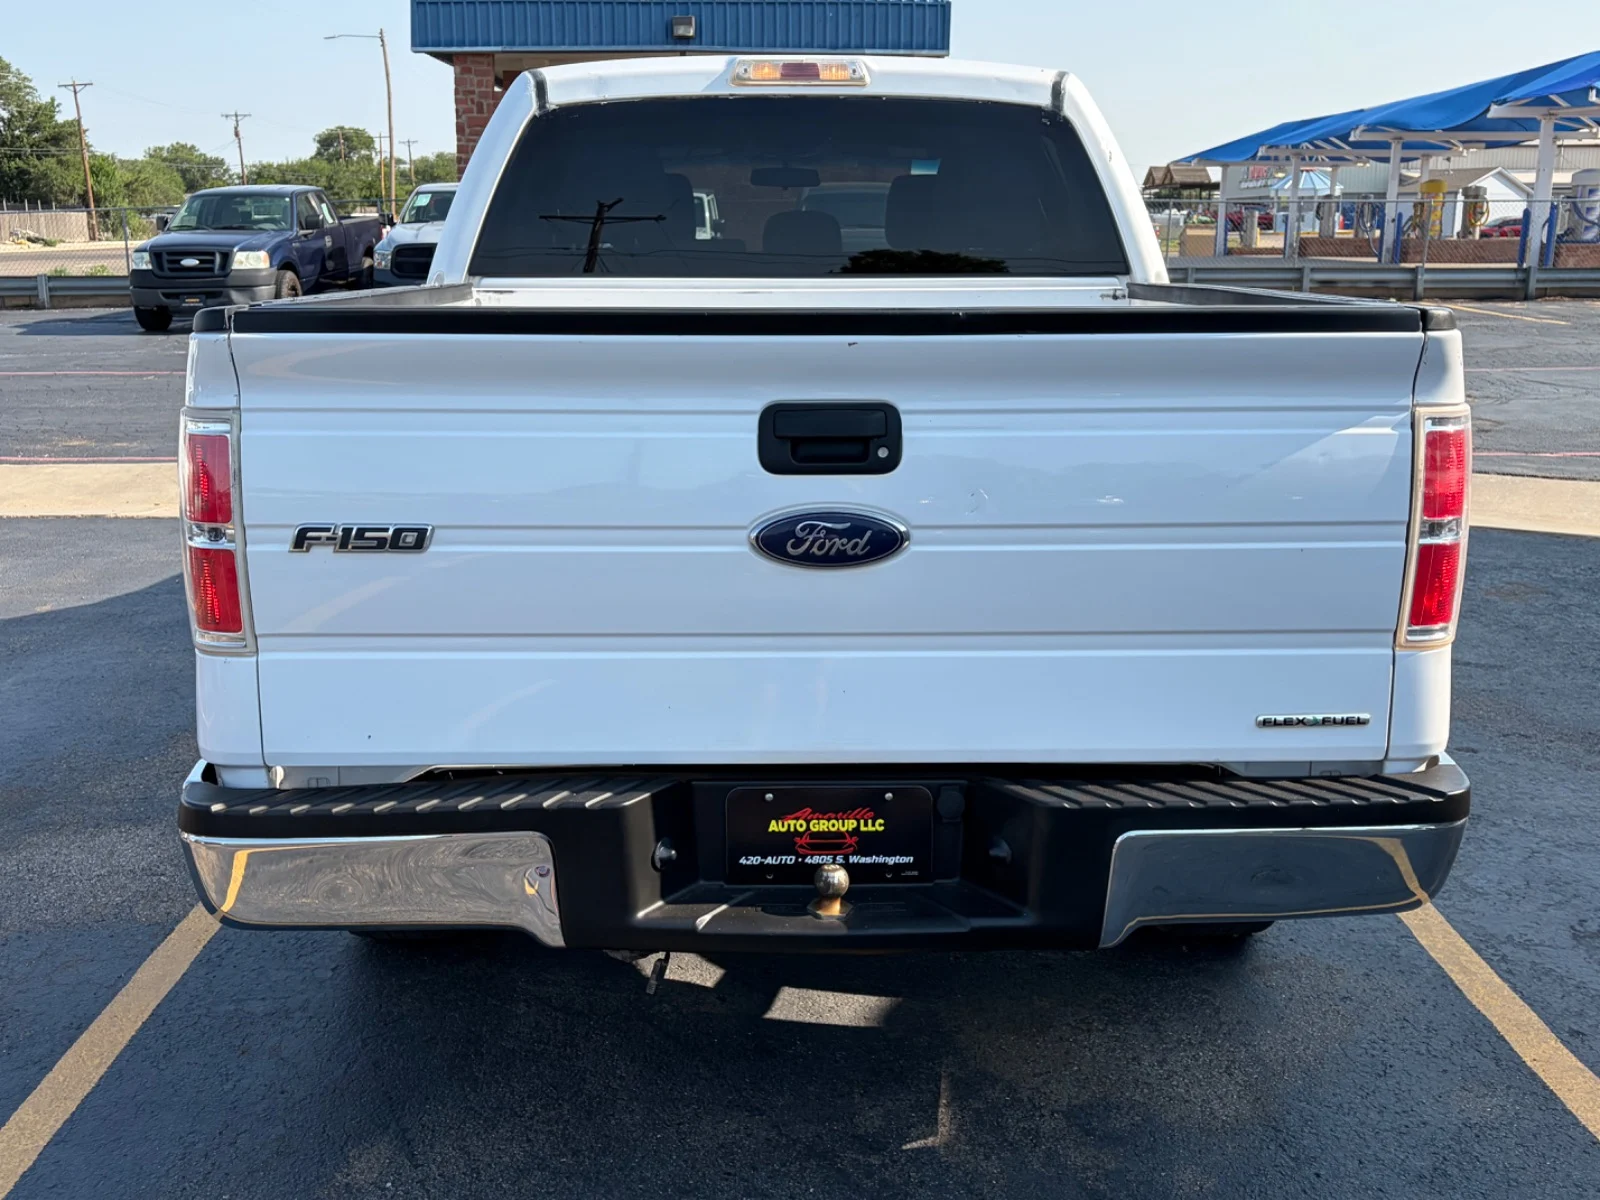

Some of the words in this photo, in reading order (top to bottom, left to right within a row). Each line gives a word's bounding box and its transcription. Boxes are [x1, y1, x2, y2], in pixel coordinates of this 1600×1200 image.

[290, 523, 434, 553] F-150
[786, 520, 872, 556] Ford
[1262, 716, 1308, 727] FLEX
[1321, 715, 1367, 726] FUEL
[781, 807, 875, 821] Amarillo
[768, 819, 807, 832] AUTO
[809, 819, 857, 832] GROUP
[860, 818, 885, 832] LLC
[739, 855, 796, 865] 420-AUTO
[804, 855, 833, 864] 4805
[835, 855, 846, 864] S.
[849, 855, 914, 865] Washington
